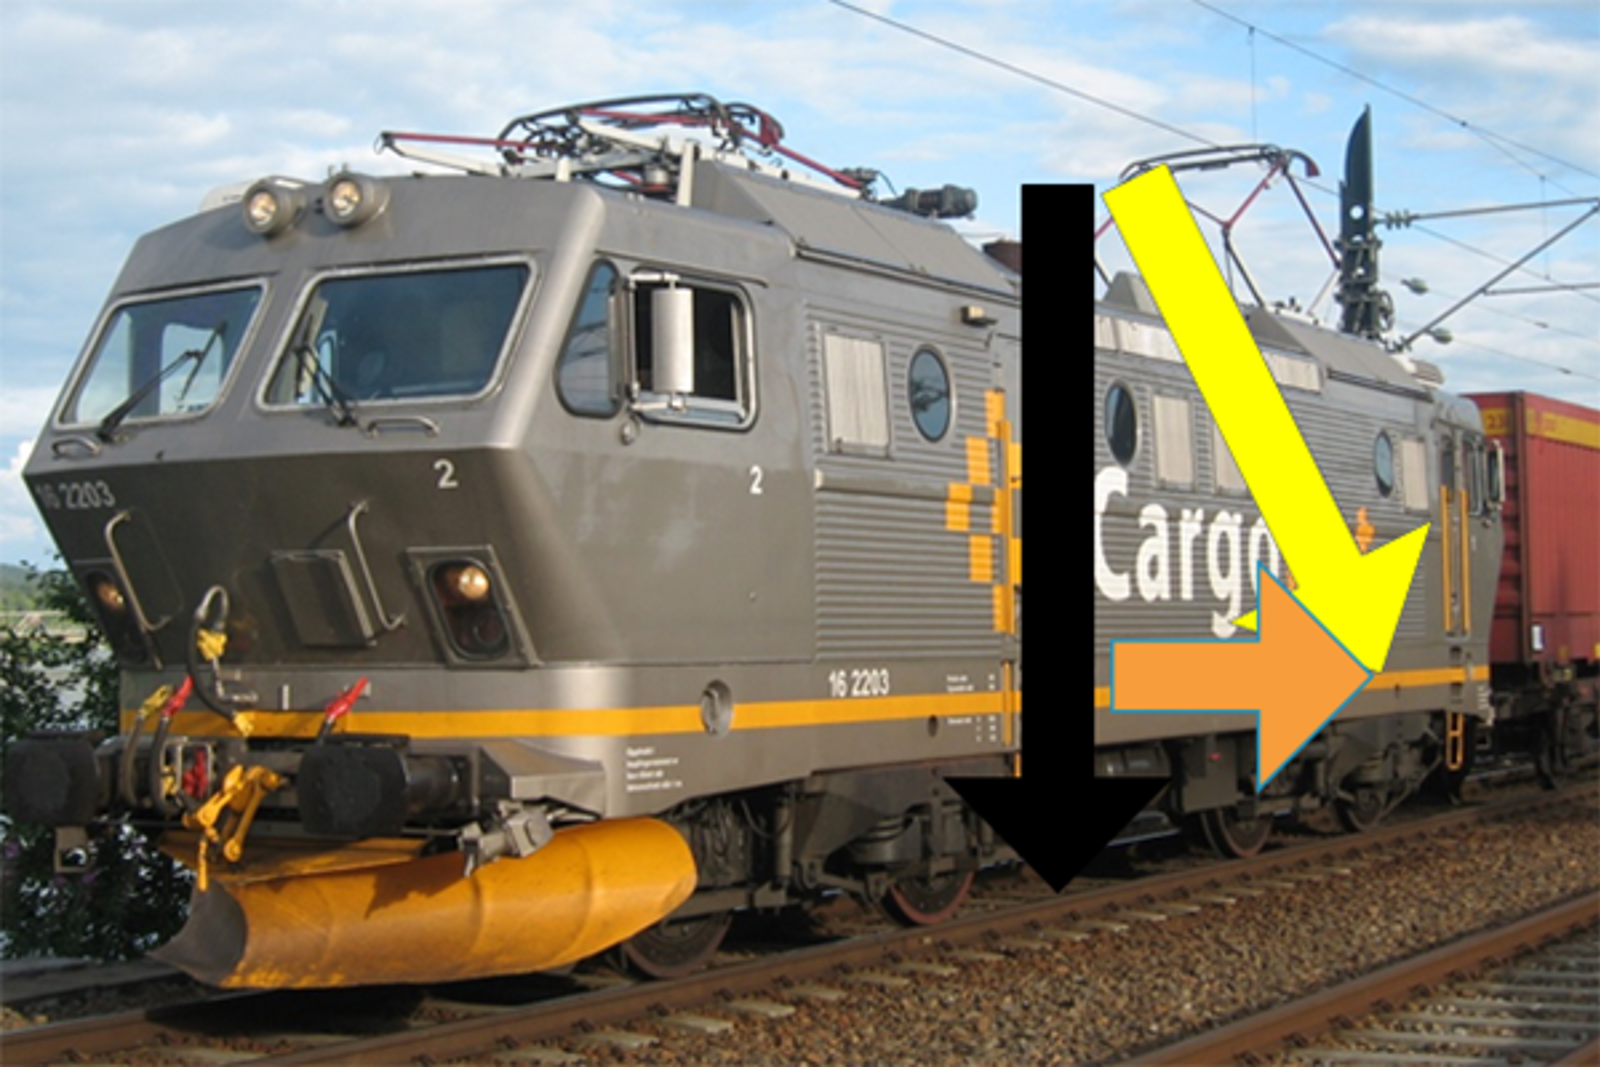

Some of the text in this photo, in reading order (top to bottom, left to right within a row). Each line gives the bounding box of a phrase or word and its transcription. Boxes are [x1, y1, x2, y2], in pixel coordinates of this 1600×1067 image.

[433, 459, 458, 489] 2
[750, 465, 763, 494] 2
[58, 479, 116, 510] 2203
[1094, 466, 1280, 639] Cargo
[829, 668, 890, 698] 16 2203
